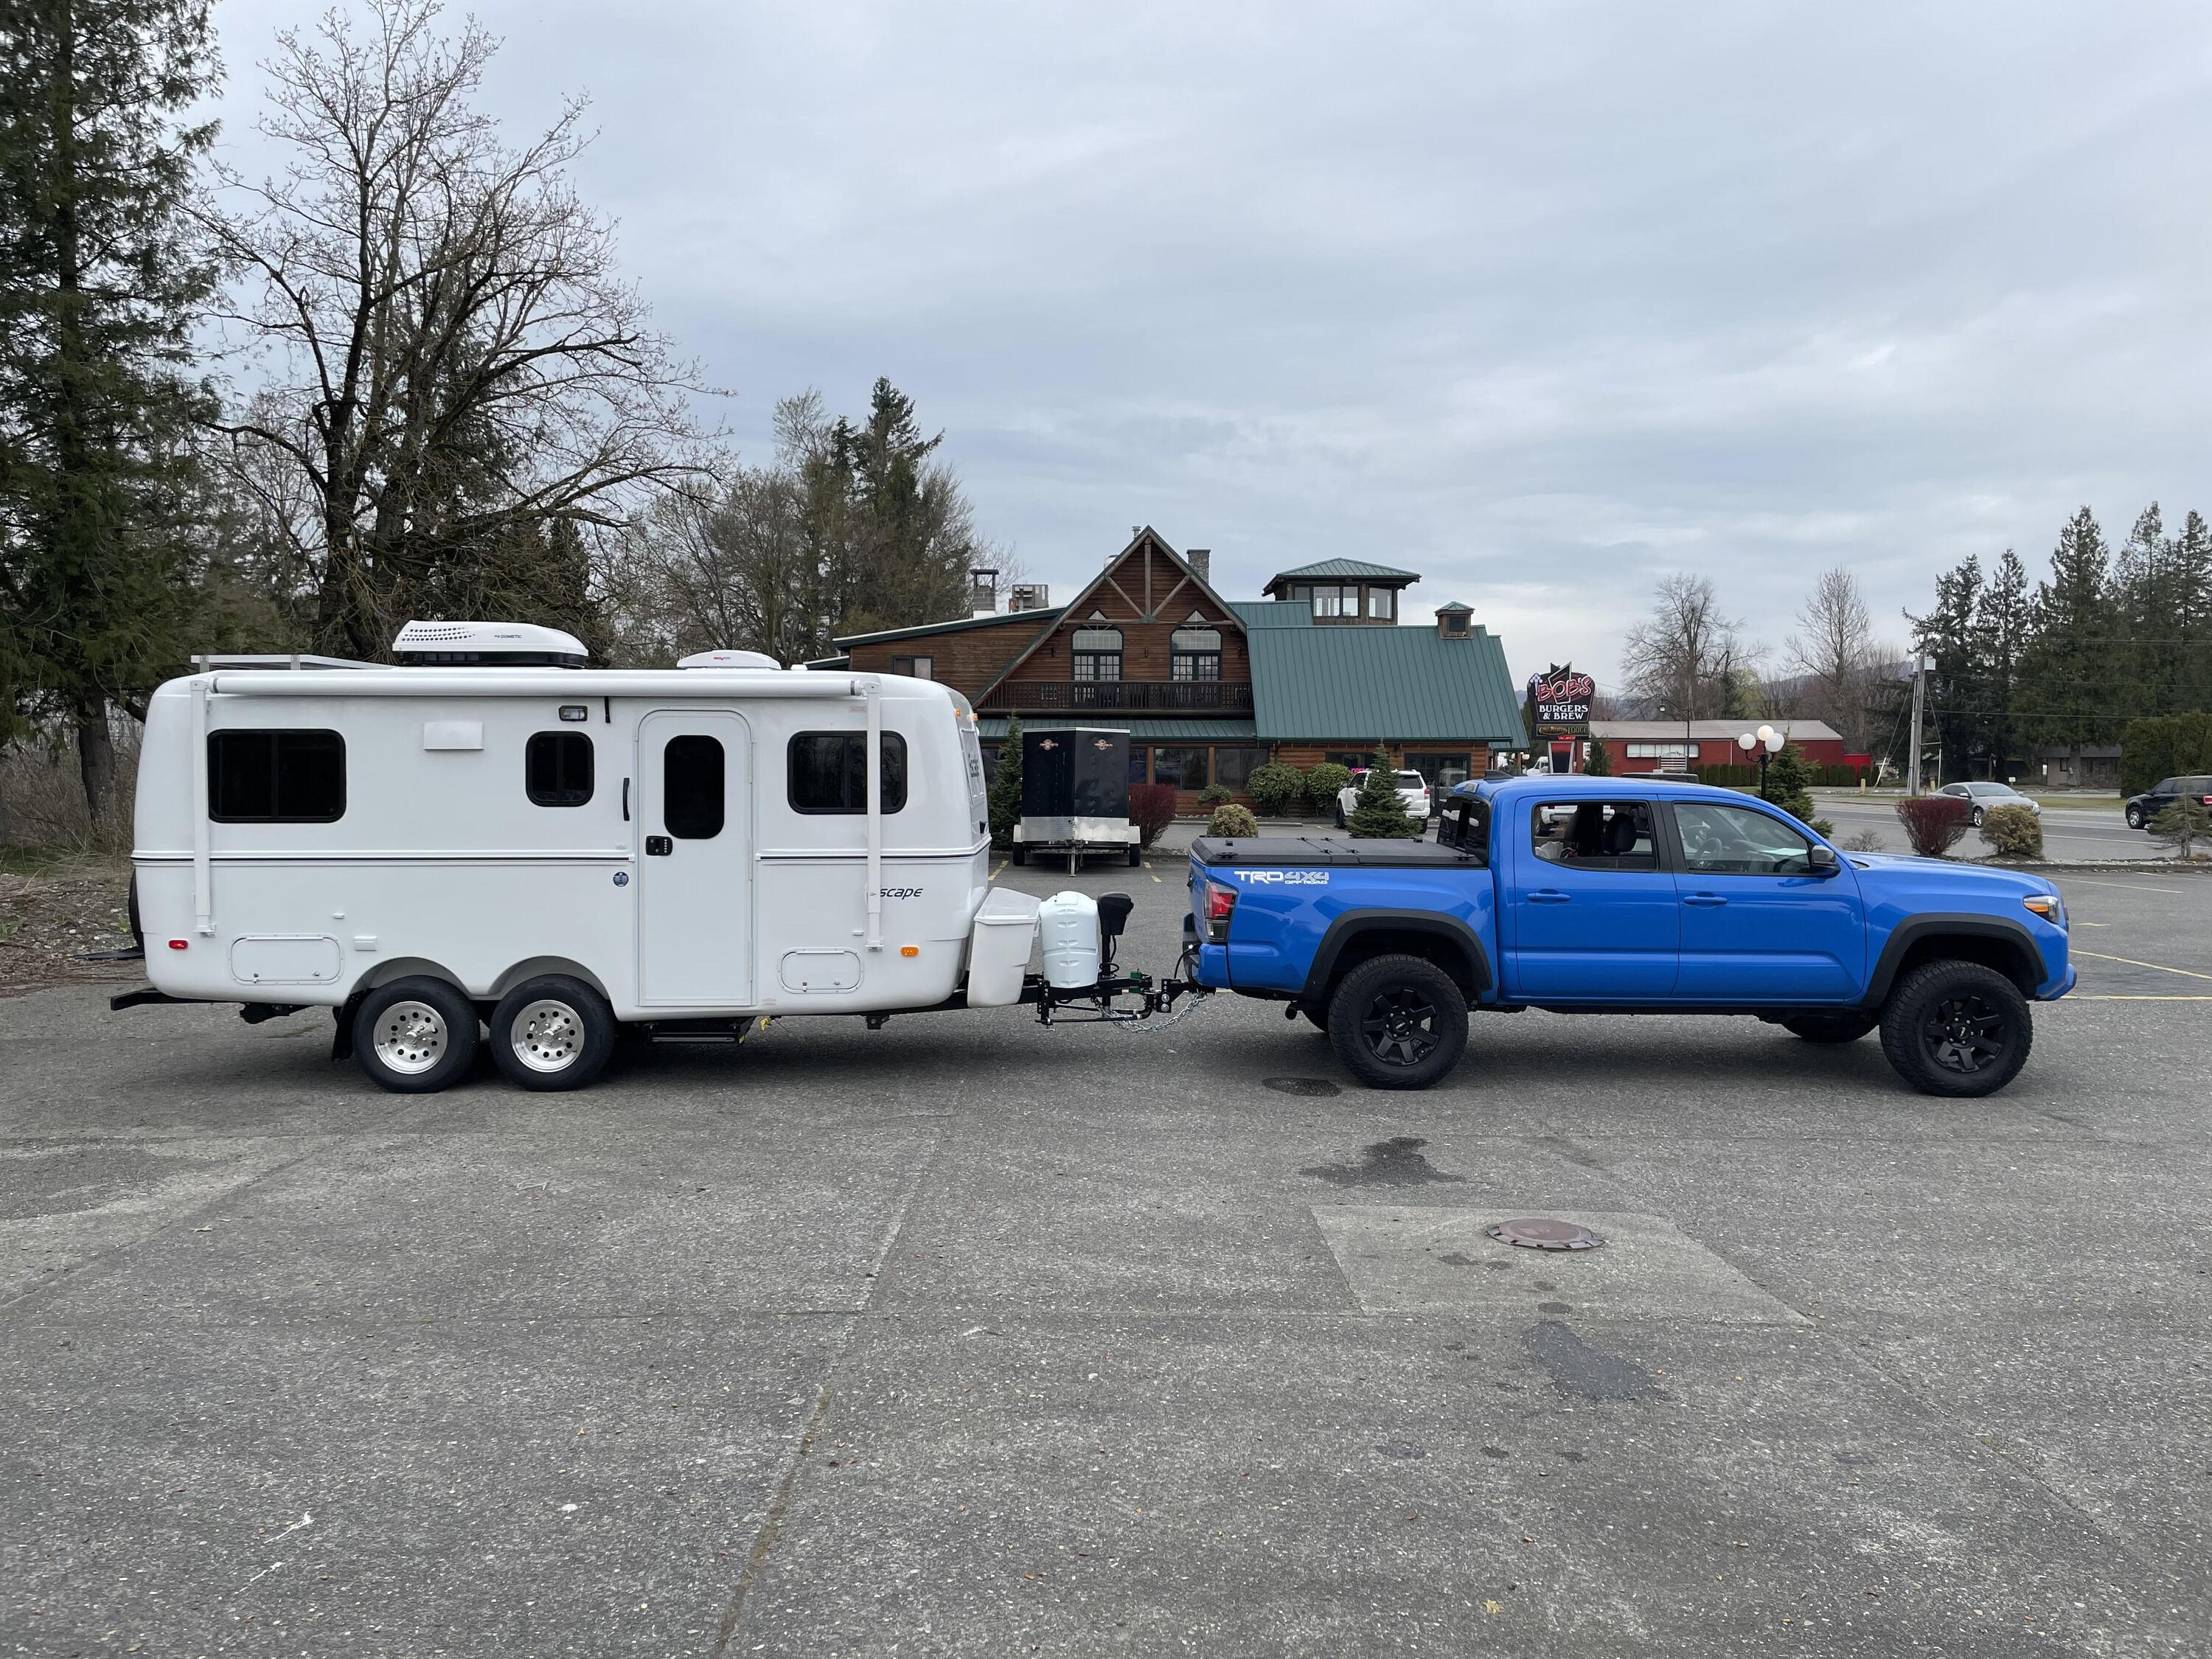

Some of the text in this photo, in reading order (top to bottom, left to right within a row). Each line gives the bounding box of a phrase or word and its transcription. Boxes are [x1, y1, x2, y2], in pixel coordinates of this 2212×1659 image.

[1537, 675, 1592, 702] BOB'S
[1539, 704, 1589, 713] BURGERS
[1543, 712, 1584, 720] & BREW
[1234, 871, 1283, 884] TRD
[880, 888, 924, 900] scape
